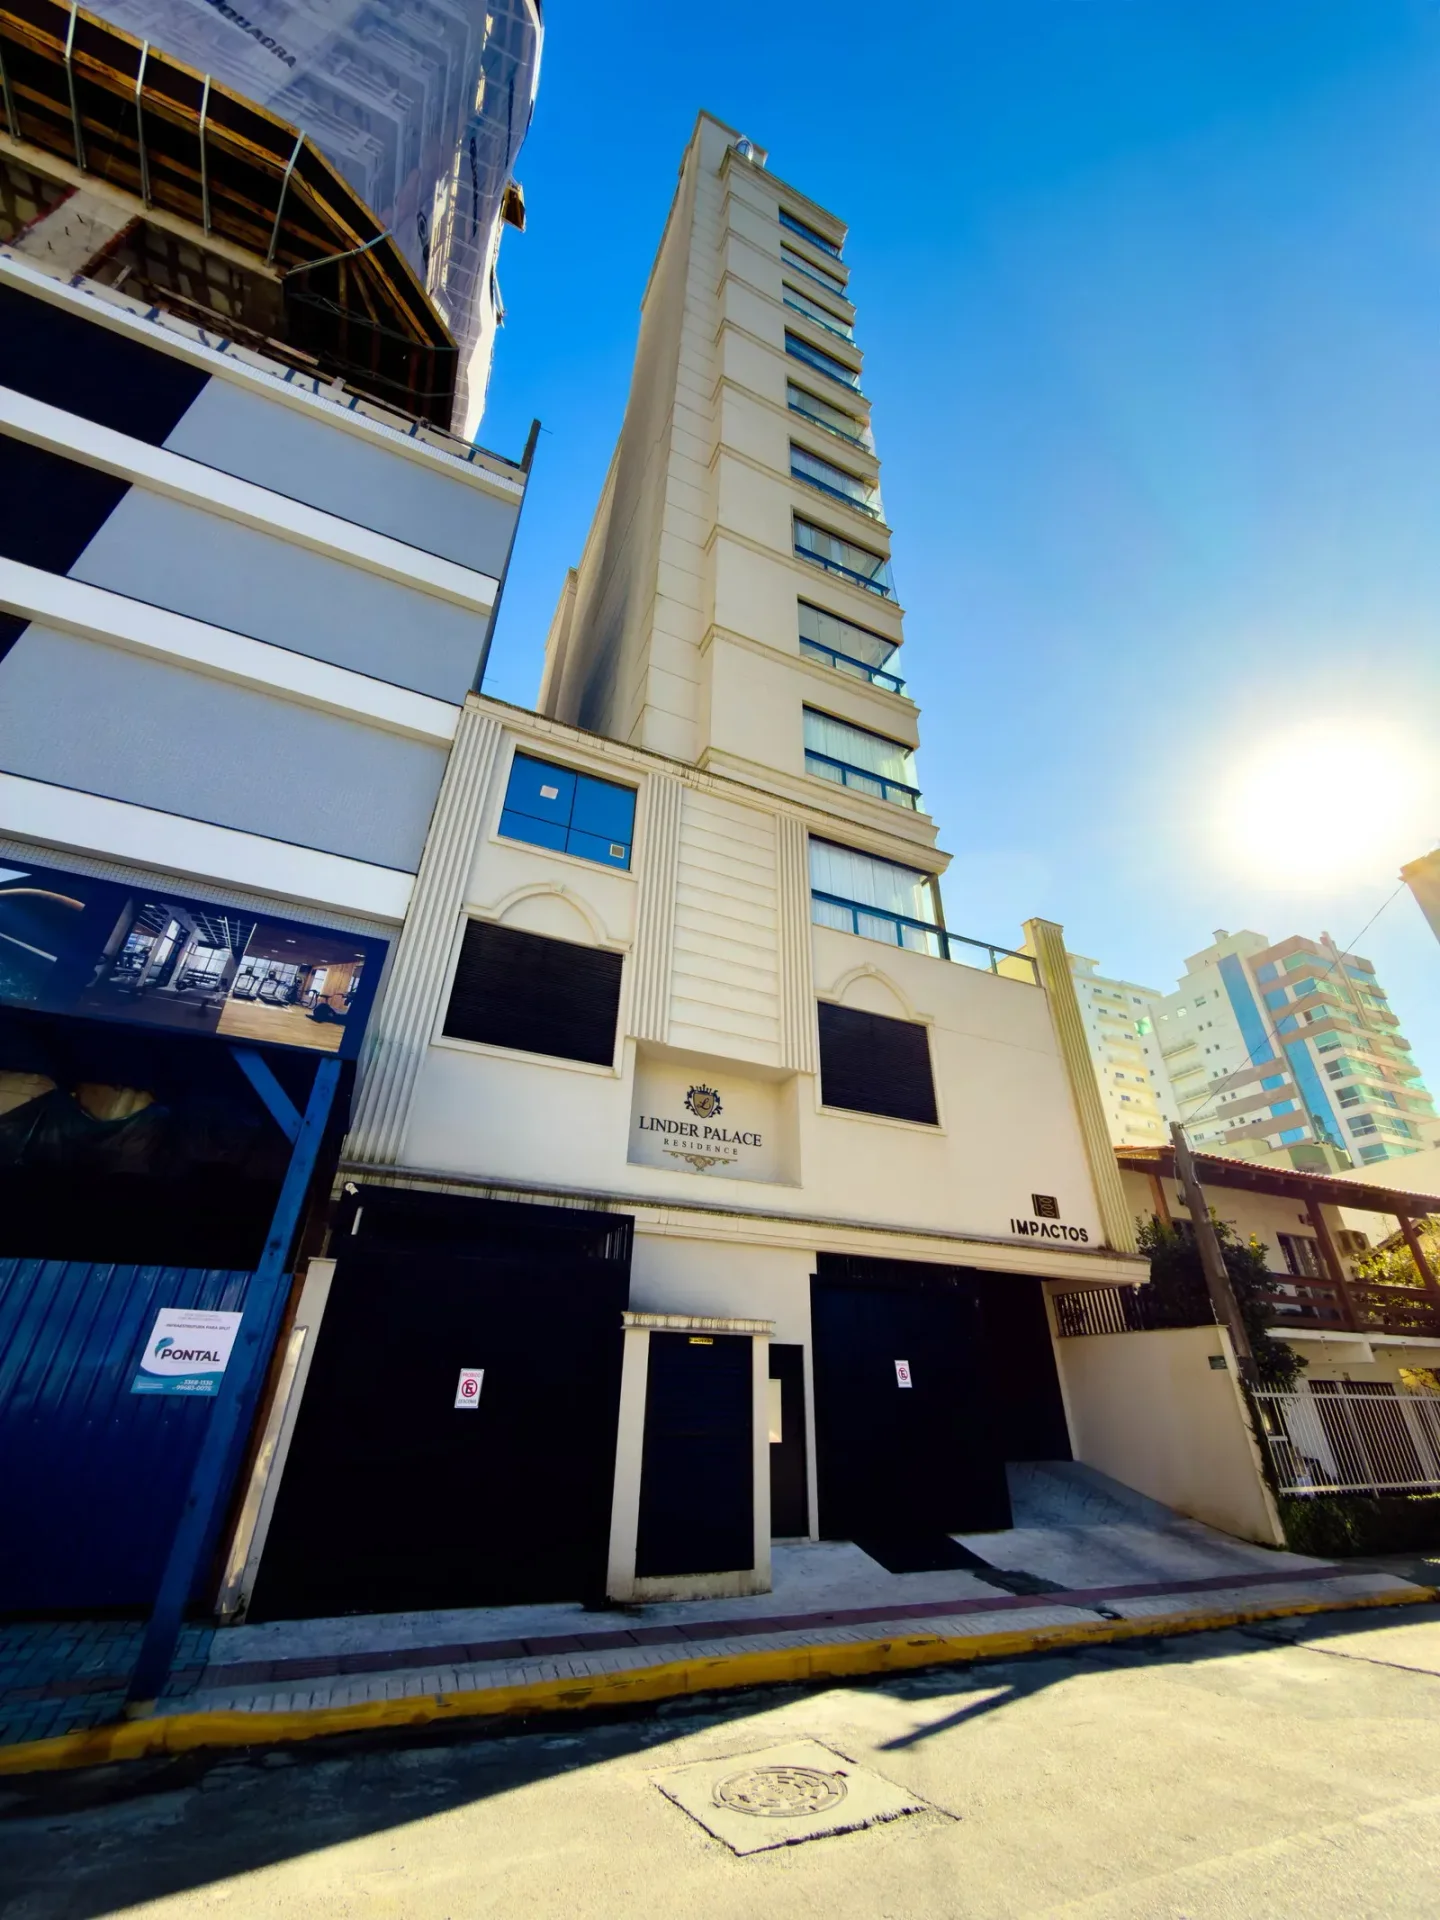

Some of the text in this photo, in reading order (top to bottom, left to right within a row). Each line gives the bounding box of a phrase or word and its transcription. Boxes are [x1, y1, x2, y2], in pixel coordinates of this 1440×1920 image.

[639, 1115, 762, 1147] LINDER PALACE
[663, 1138, 738, 1155] RESIDENCE
[1010, 1218, 1089, 1242] IMPACTOS
[160, 1348, 221, 1362] PONTAL
